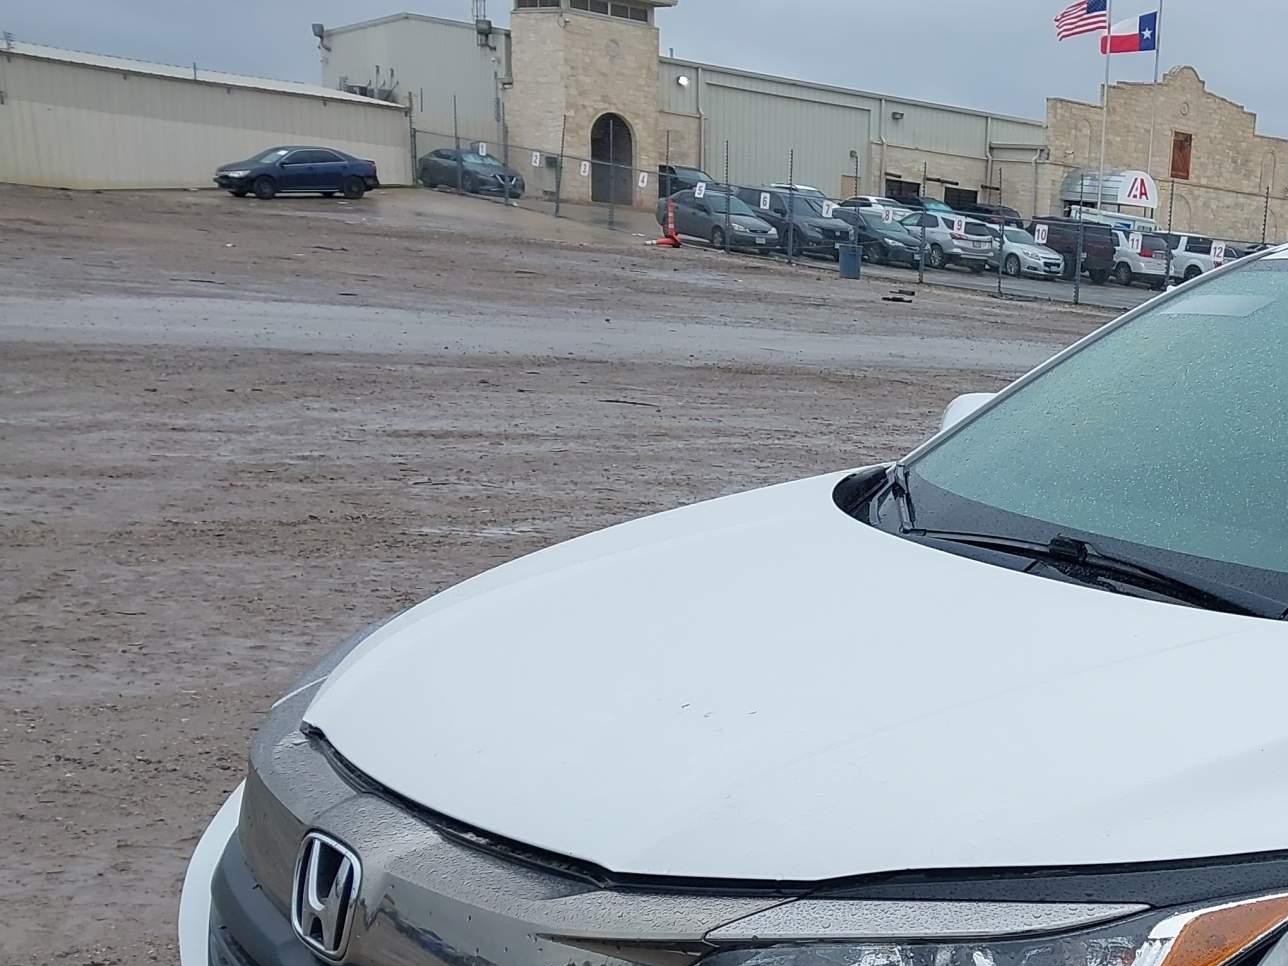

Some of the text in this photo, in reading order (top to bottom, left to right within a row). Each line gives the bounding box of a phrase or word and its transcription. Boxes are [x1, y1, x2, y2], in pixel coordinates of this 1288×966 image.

[696, 184, 703, 196] 5
[825, 204, 831, 215] 7
[884, 209, 890, 221] 8
[957, 219, 963, 231] 9
[1036, 228, 1047, 241] 10
[1130, 238, 1140, 249] 11
[1213, 246, 1223, 258] 12
